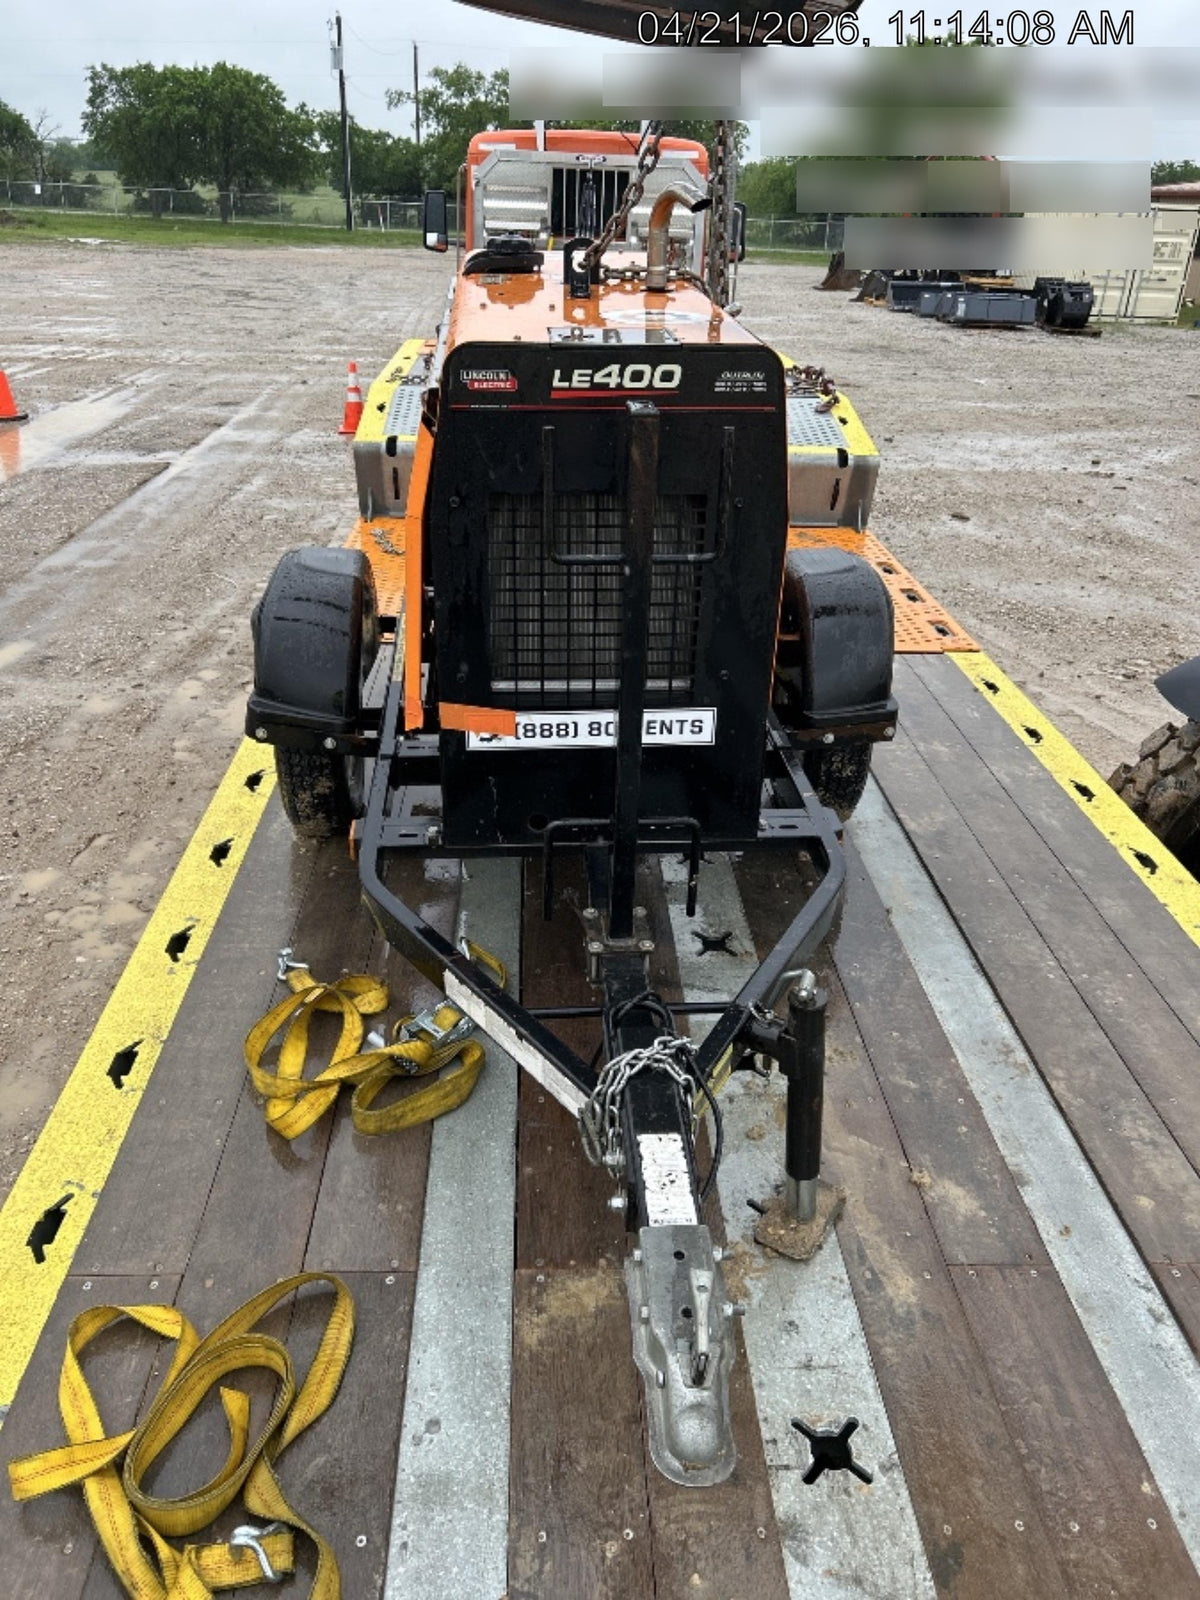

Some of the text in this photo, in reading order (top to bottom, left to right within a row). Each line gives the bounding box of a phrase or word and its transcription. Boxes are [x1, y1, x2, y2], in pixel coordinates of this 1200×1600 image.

[463, 370, 507, 380] LINCOLN
[552, 364, 682, 388] LE400
[515, 721, 578, 740] (888)
[645, 719, 703, 735] ENTS
